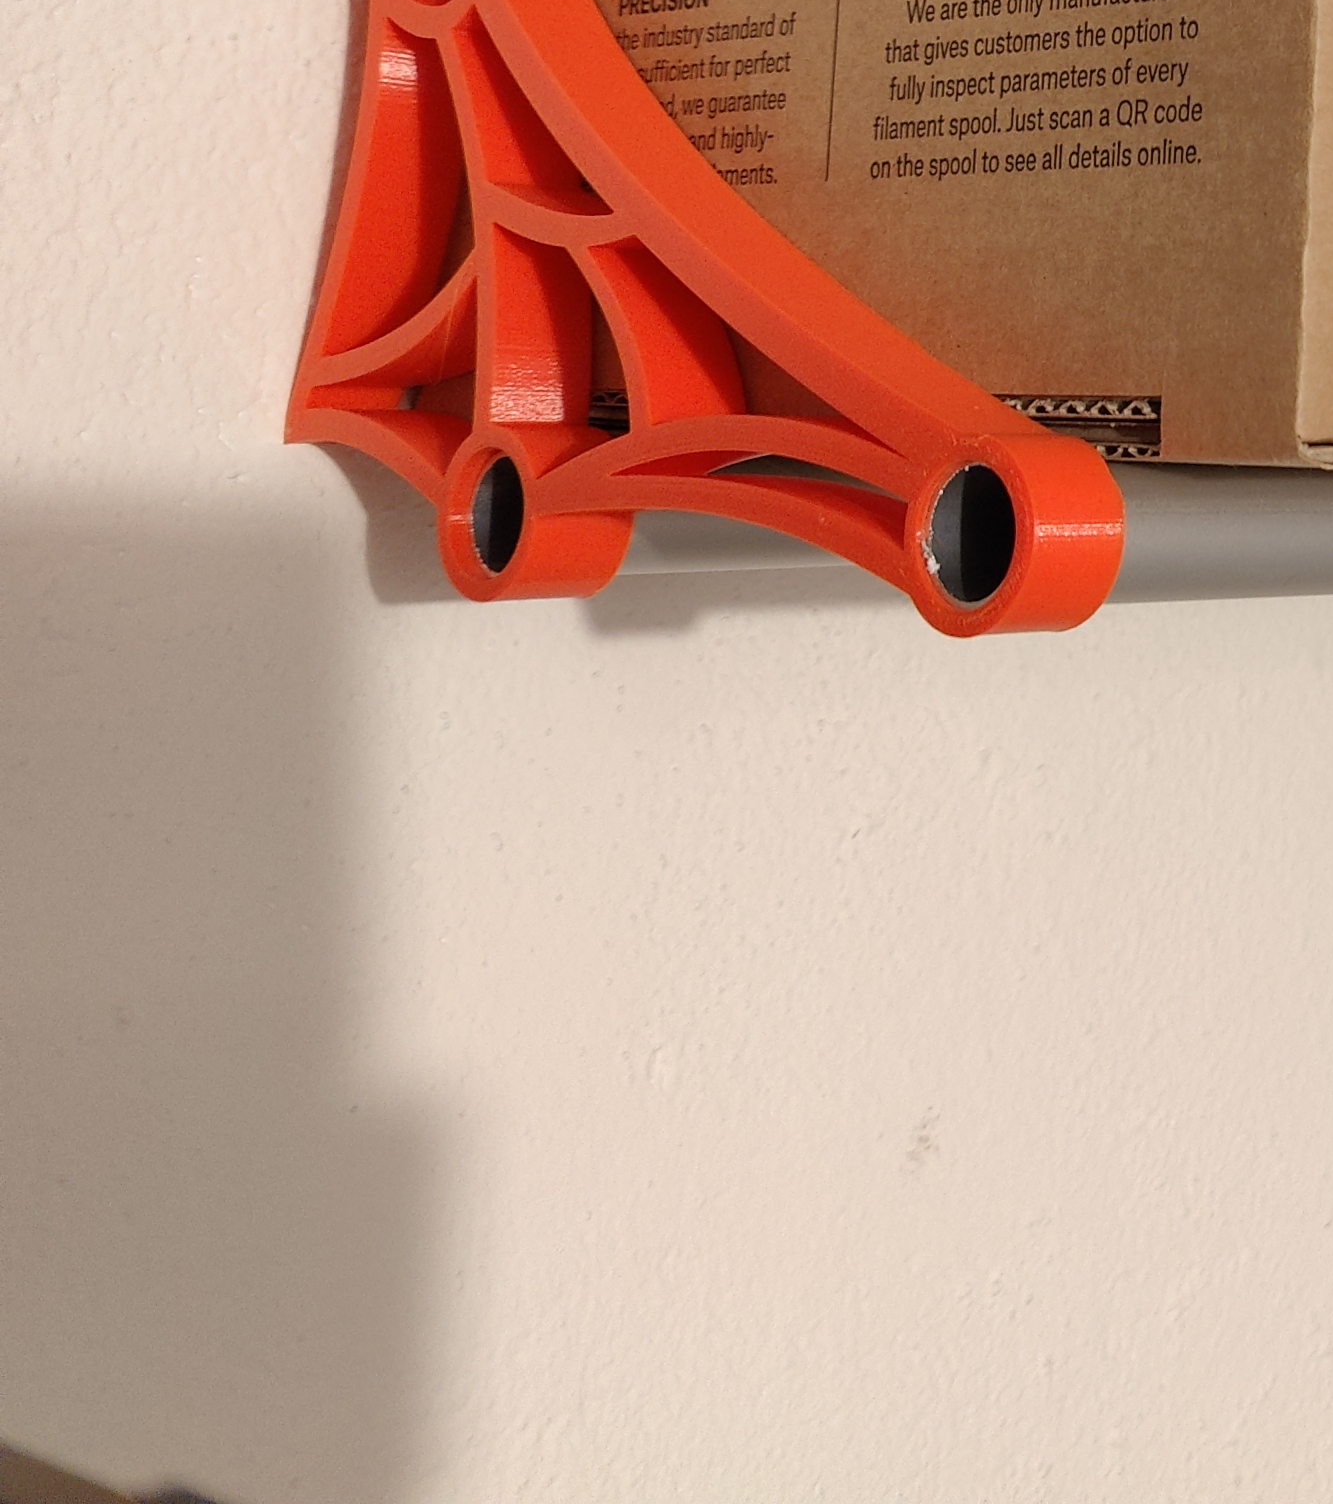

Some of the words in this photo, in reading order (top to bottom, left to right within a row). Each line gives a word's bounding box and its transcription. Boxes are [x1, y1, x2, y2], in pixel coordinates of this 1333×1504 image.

[940, 1, 968, 21] are
[889, 75, 926, 105] fully
[930, 71, 995, 102] inspect
[999, 64, 1106, 99] parameters
[1111, 60, 1132, 85] of
[1136, 61, 1189, 87] every
[872, 114, 944, 141] filament
[948, 107, 1001, 141] spool.
[1005, 106, 1044, 132] Just
[1048, 109, 1092, 130] scan
[1098, 107, 1110, 127] a
[1116, 98, 1148, 128] QR
[1153, 95, 1202, 124] code
[870, 160, 891, 180] on
[892, 152, 924, 178] the
[928, 148, 977, 181] spool
[981, 151, 999, 173] to
[1004, 152, 1036, 172] see
[1041, 144, 1063, 170] all
[1068, 141, 1132, 169] details
[1137, 139, 1201, 166] online.
